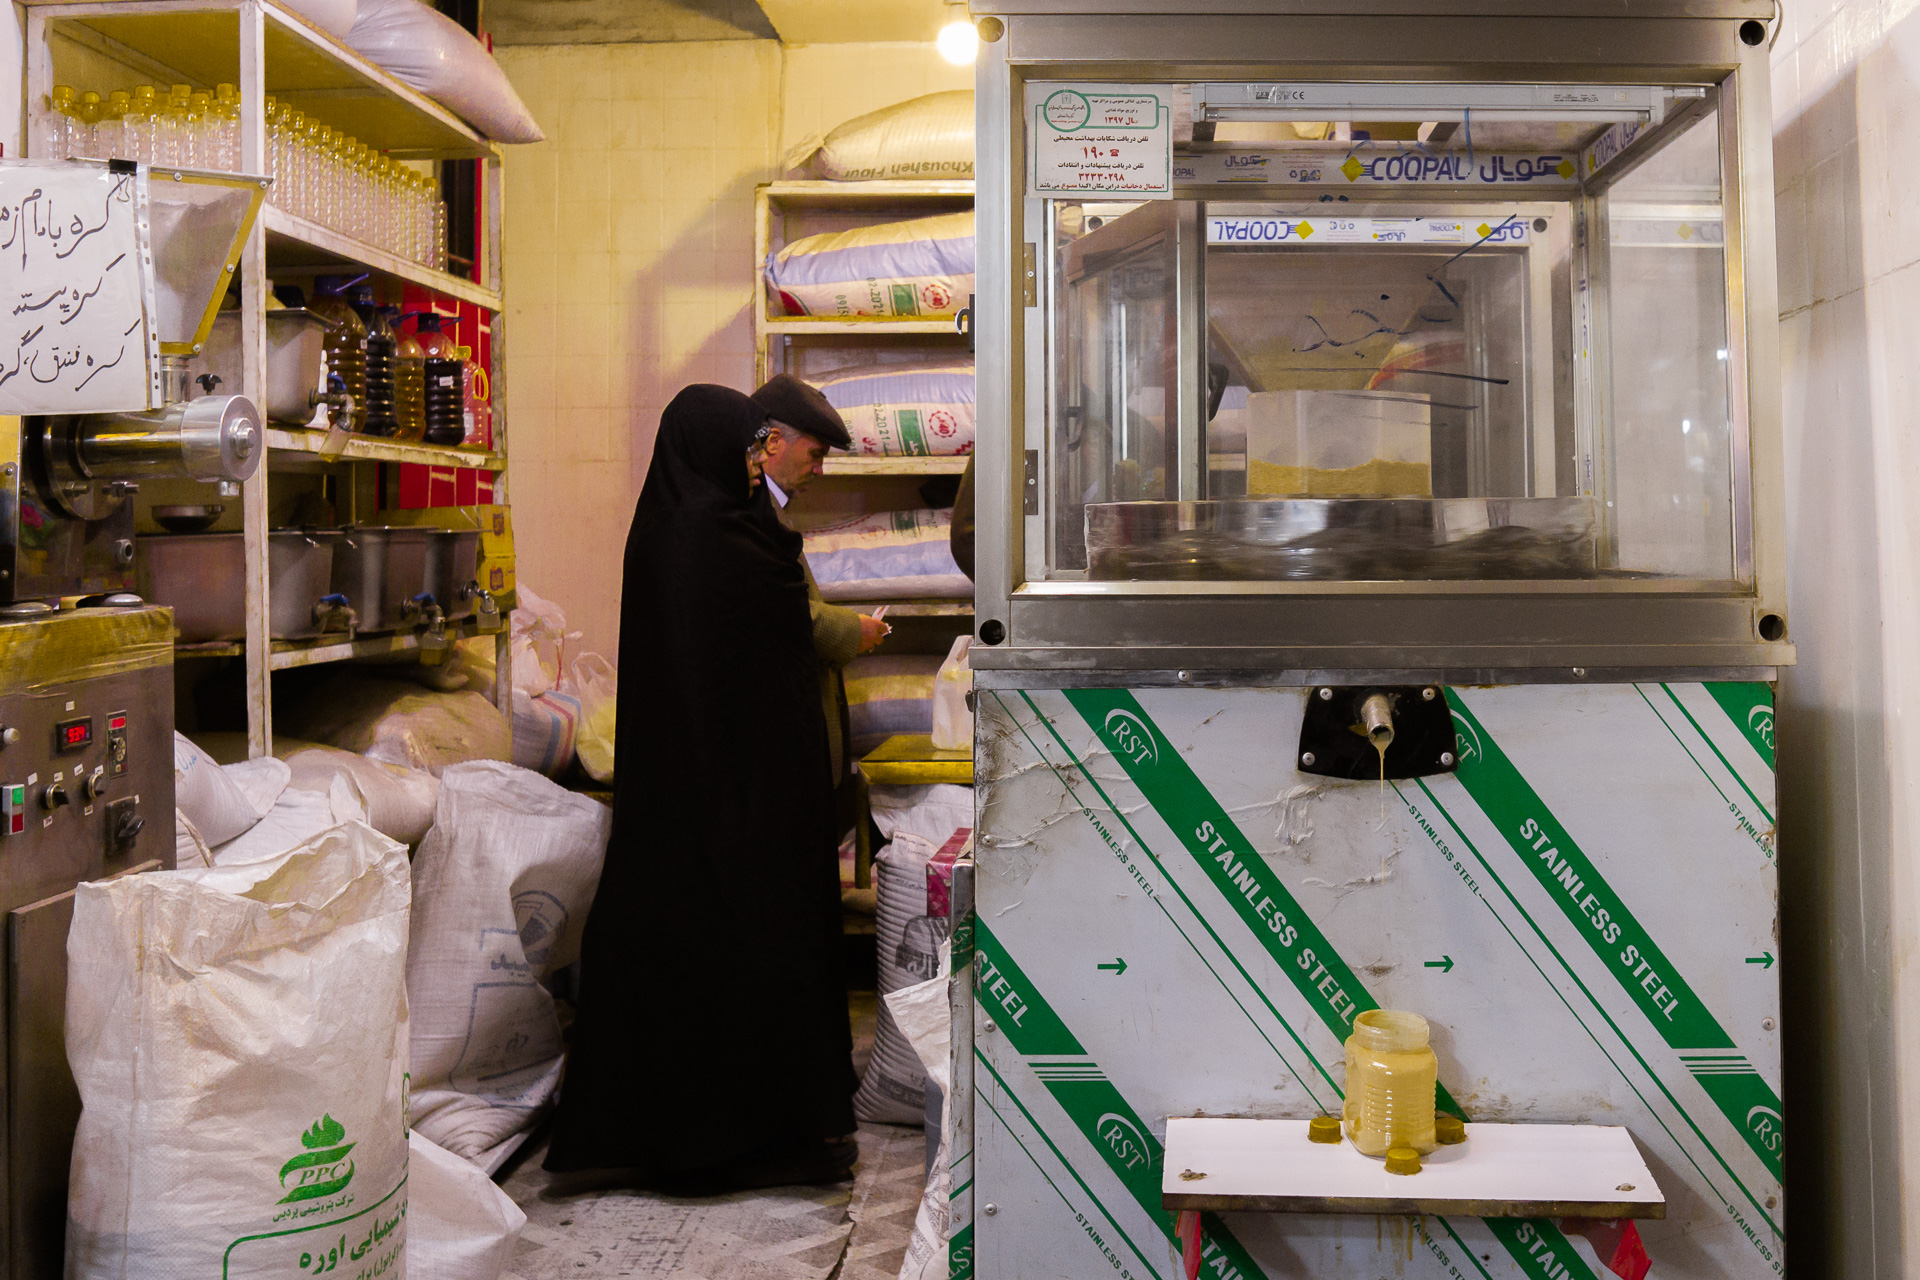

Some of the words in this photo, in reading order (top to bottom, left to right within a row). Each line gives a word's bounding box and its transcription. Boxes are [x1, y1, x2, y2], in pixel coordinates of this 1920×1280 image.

[1053, 134, 1074, 143] محیطی
[1083, 146, 1104, 159] ۱۹۰
[1137, 135, 1149, 143] تلفن
[1132, 162, 1145, 170] تلفن
[1370, 156, 1468, 182] COOPAL
[1214, 221, 1290, 241] COOPAL
[1111, 719, 1153, 766] RST
[1082, 806, 1129, 866] STAINLESS
[1128, 864, 1156, 899] STEEL
[1408, 805, 1455, 862] STAINLESS
[1453, 861, 1480, 896] STEEL
[1195, 820, 1298, 948] STAINLESS
[1296, 948, 1357, 1026] STEEL
[1519, 817, 1622, 945] STAINLESS
[1620, 944, 1679, 1022] STEEL
[1103, 1123, 1146, 1171] RST
[298, 1161, 346, 1186] PPC
[1075, 1212, 1122, 1270] STAINLESS
[1727, 1204, 1773, 1262] STAINLESS
[299, 1243, 346, 1276] اوره
